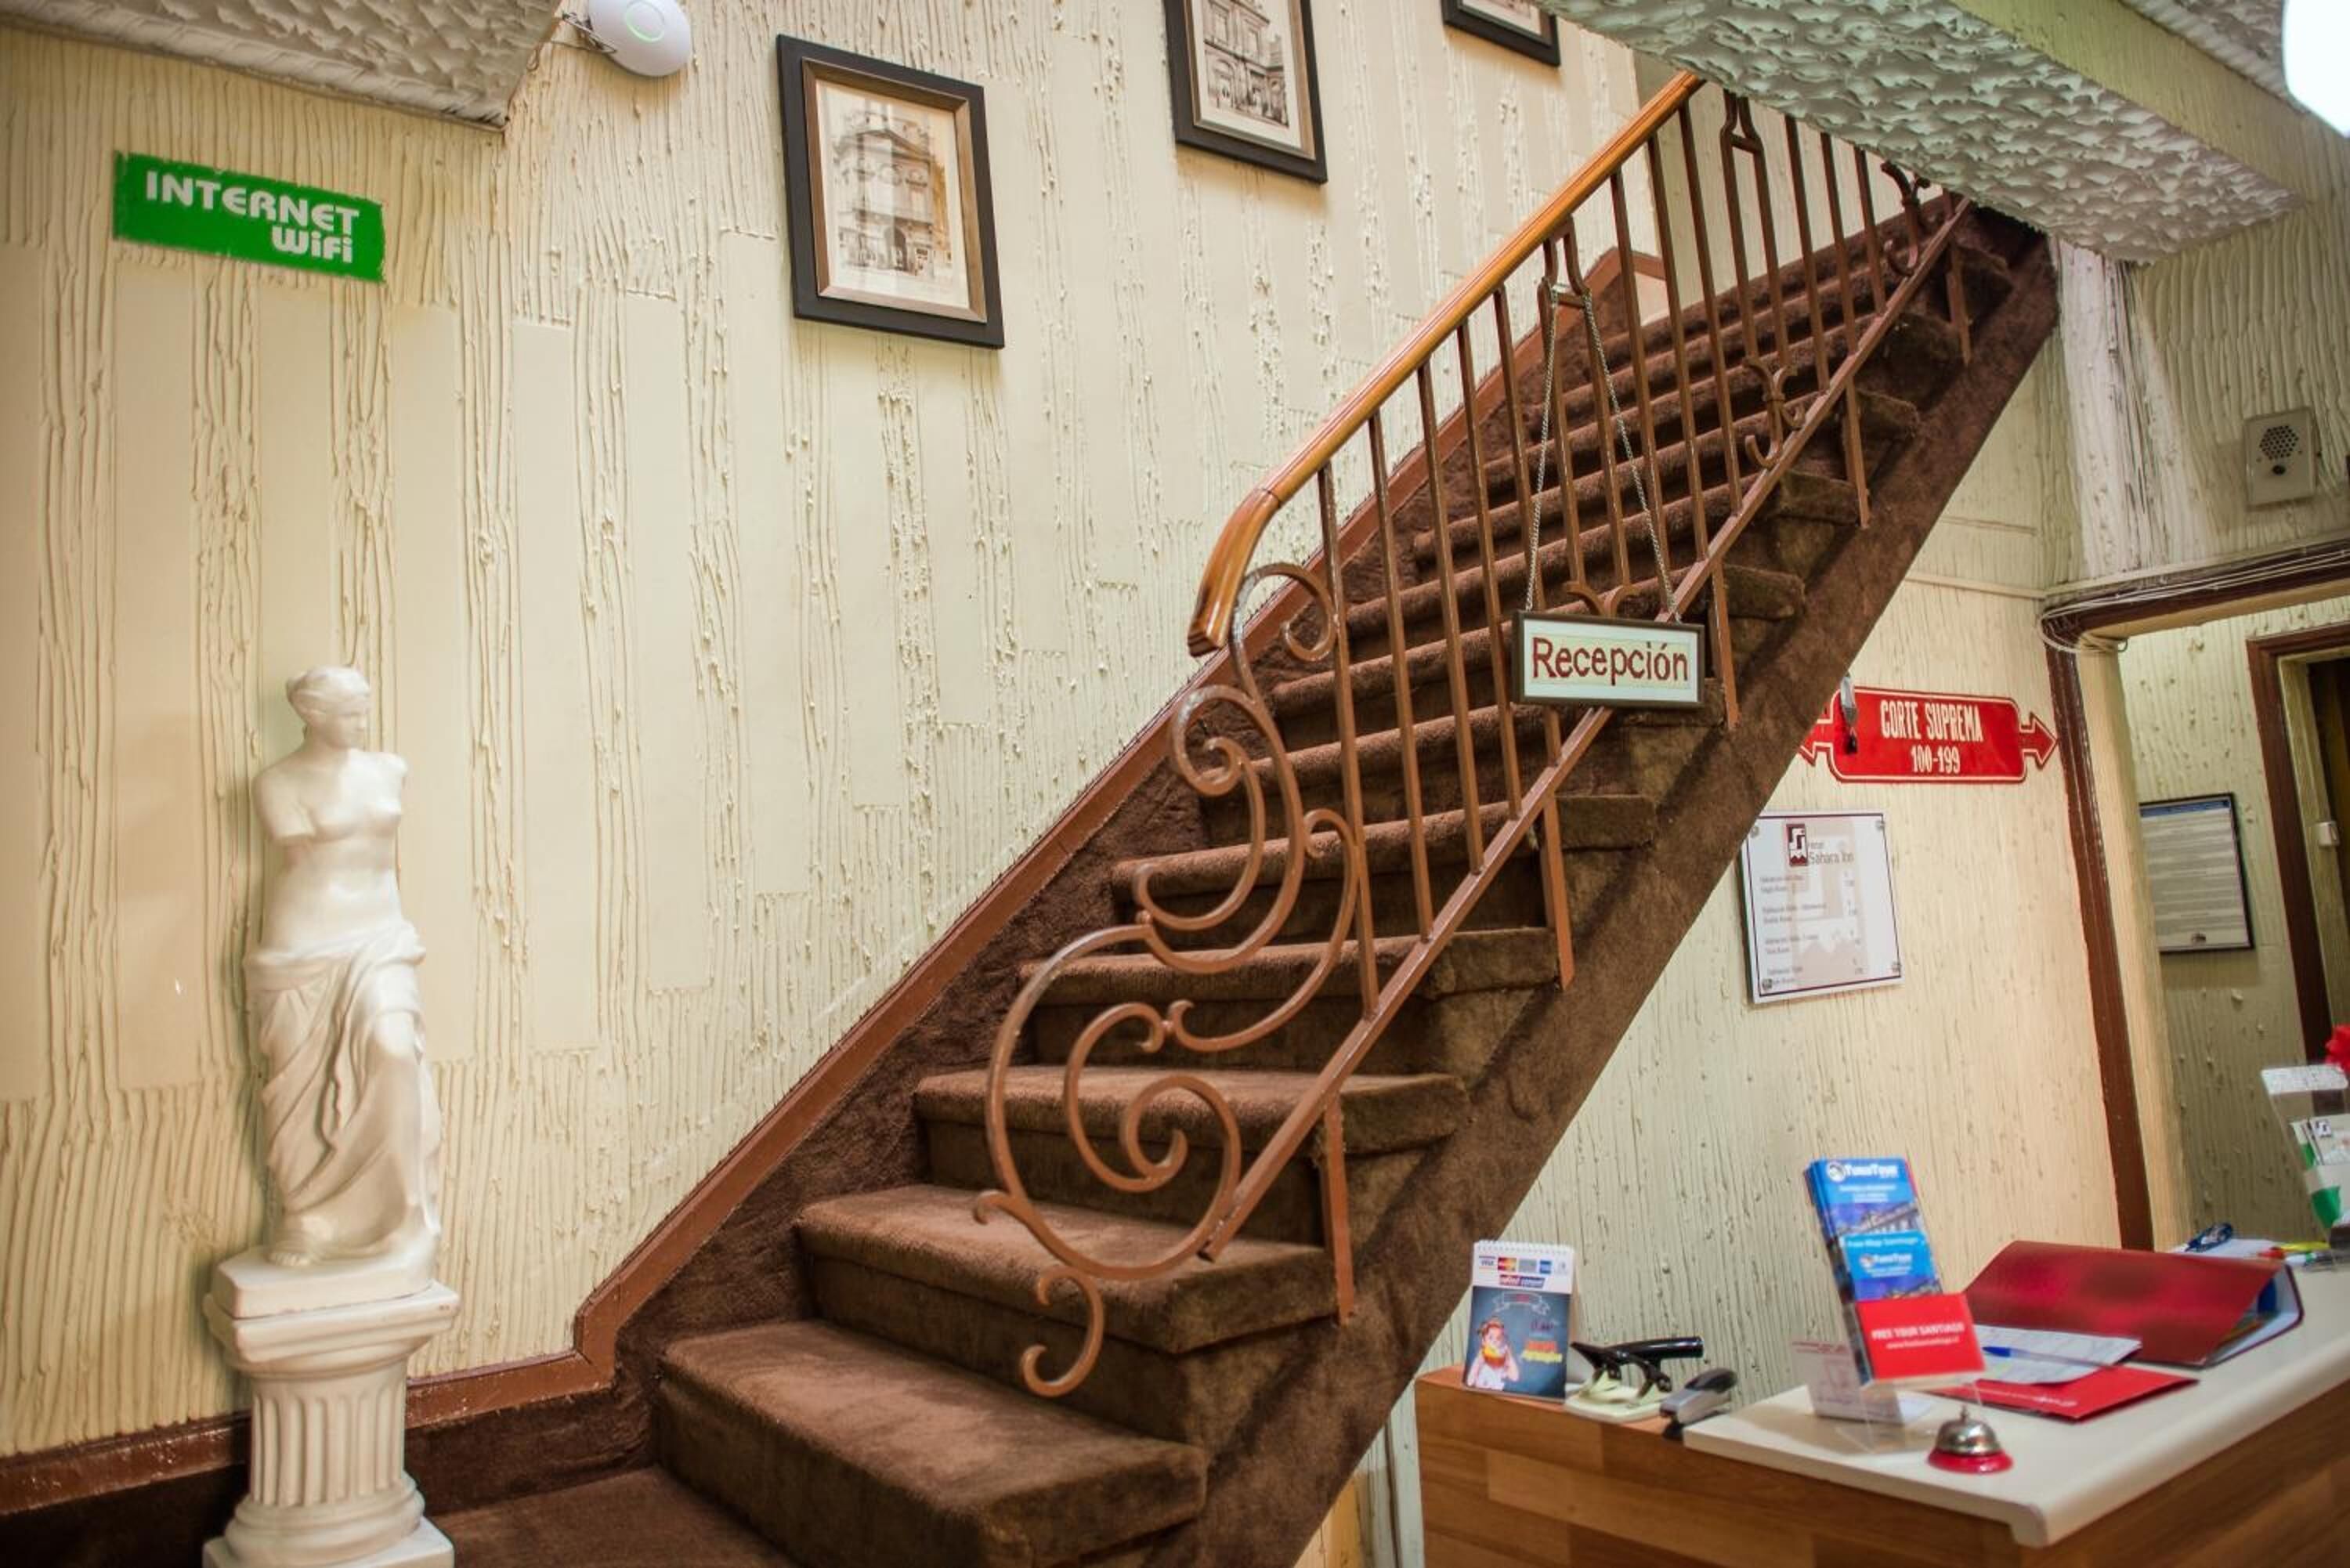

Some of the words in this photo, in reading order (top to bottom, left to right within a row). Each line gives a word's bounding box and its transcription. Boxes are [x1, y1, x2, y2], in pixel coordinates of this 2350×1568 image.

[146, 170, 360, 235] INTERNET
[1532, 637, 1688, 686] Recepción
[1880, 699, 1922, 739] CORTE
[1925, 702, 1984, 742] SUPREMA
[1910, 744, 1961, 774] 100-199
